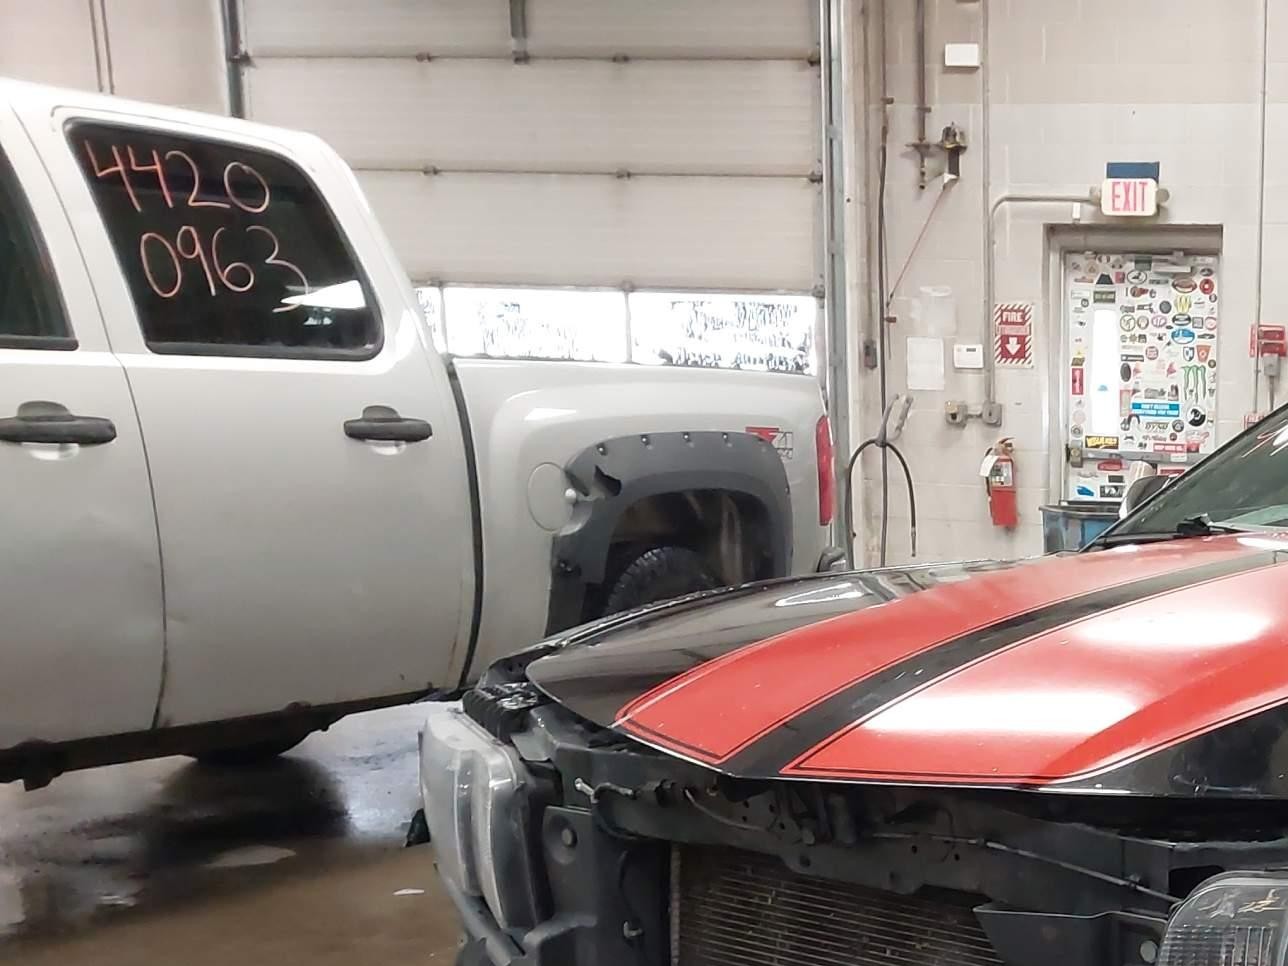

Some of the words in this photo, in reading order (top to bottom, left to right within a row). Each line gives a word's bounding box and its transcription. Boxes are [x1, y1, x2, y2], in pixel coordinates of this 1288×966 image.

[84, 139, 270, 214] 4420
[1111, 181, 1149, 212] EXIT
[139, 225, 310, 313] 0963
[1002, 311, 1024, 323] FIRE
